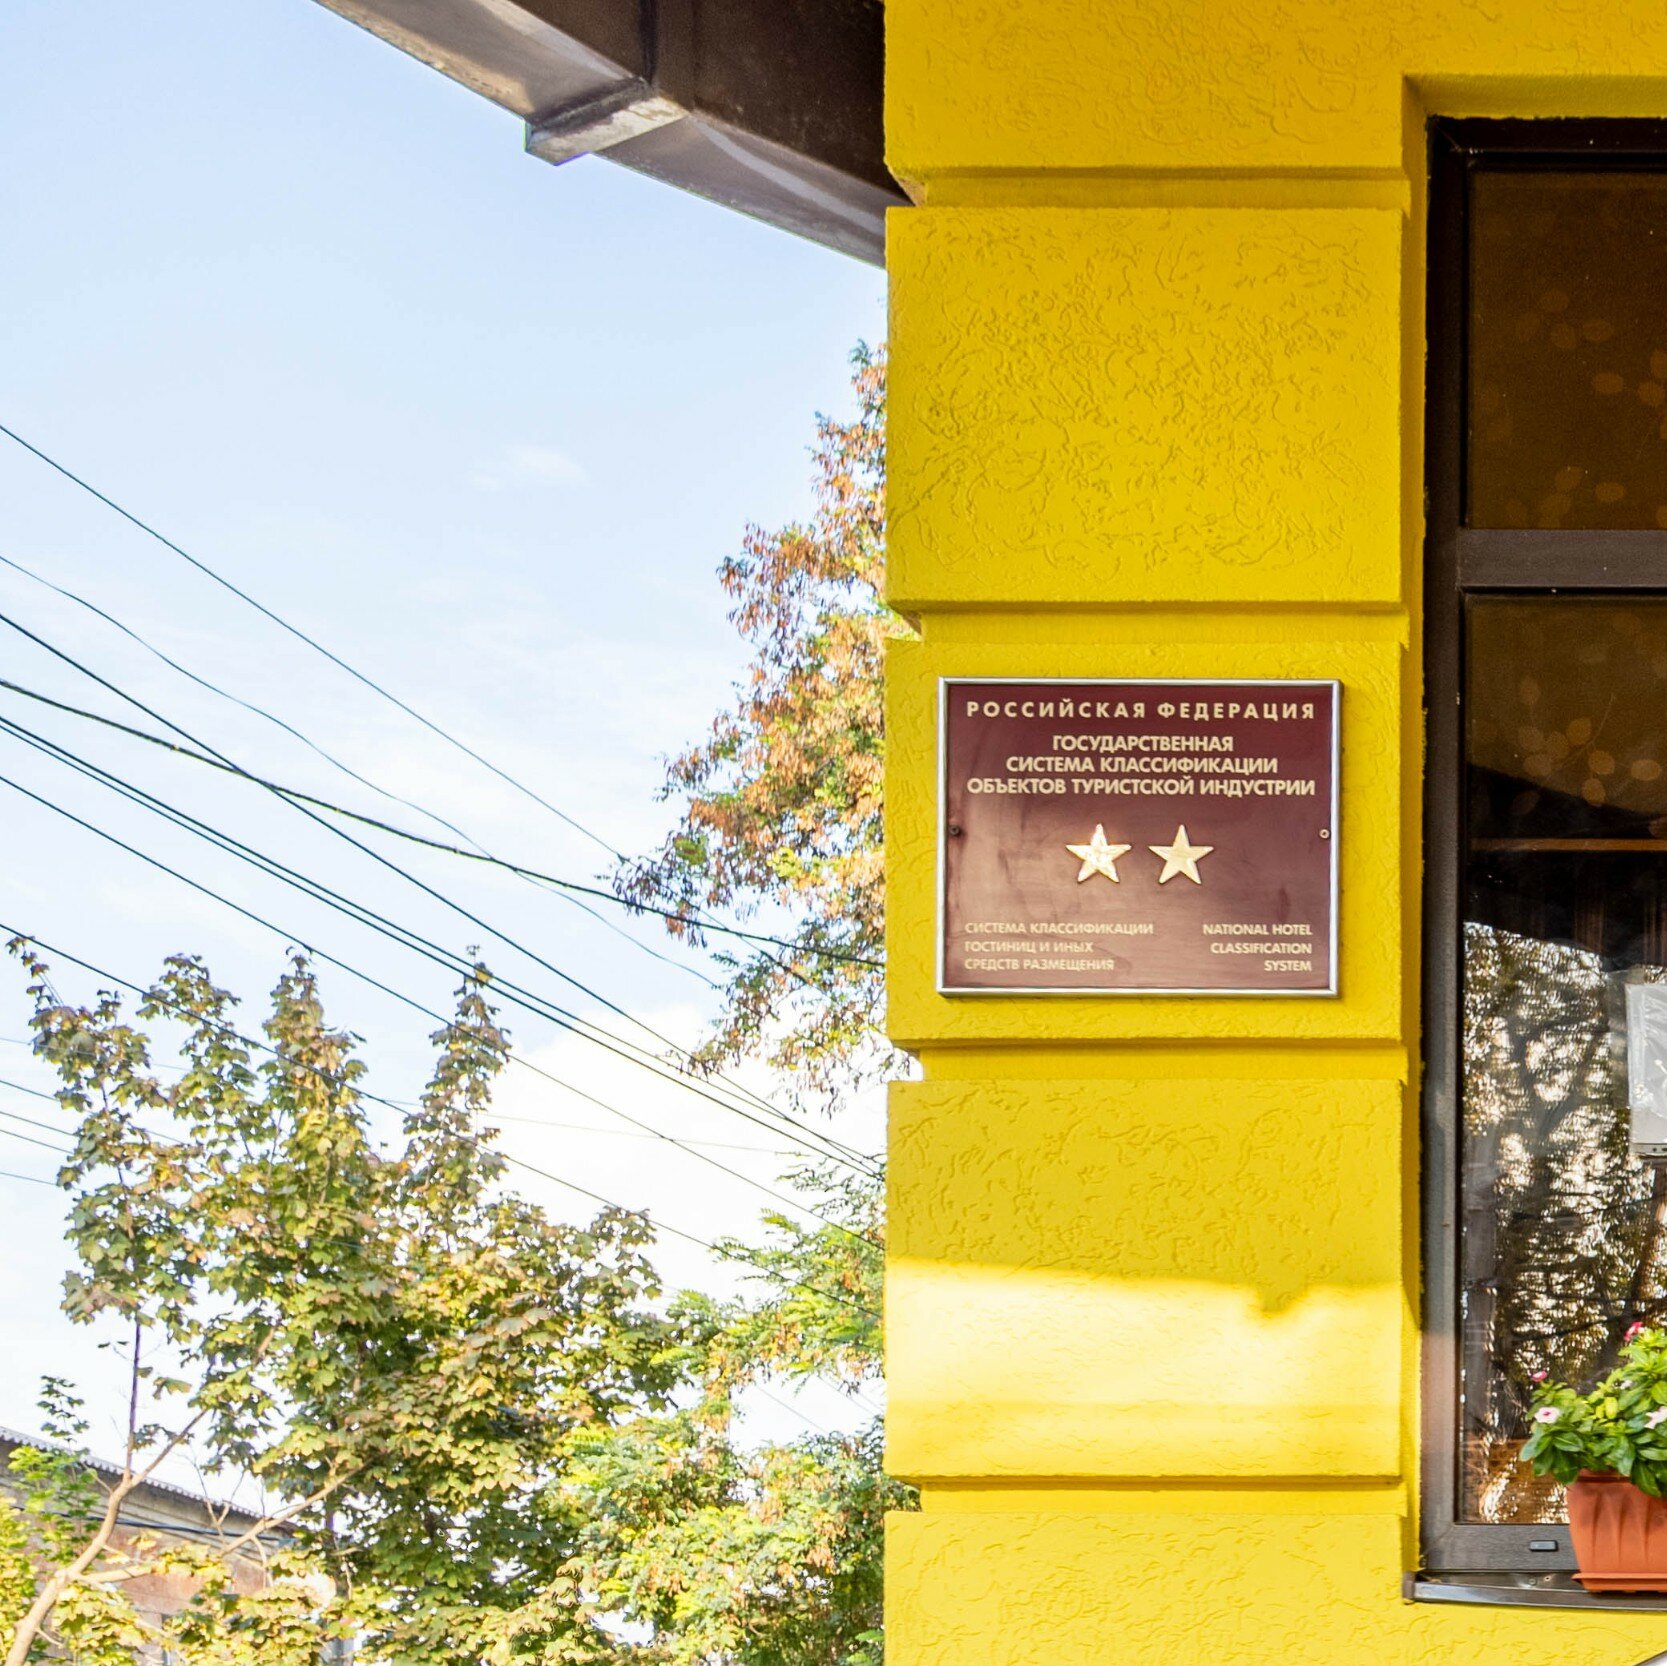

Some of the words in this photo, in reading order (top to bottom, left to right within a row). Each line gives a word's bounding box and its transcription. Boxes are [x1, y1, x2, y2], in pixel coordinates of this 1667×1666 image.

[966, 698, 1146, 719] РОССИЙСКАЯ
[1157, 702, 1315, 721] ФЕДЕРАЦИЯ
[1052, 735, 1233, 754] ГОСУДАРСТВЕННАЯ
[1006, 757, 1094, 773] СИСТЕМА
[1100, 757, 1278, 776] КЛАССИФИКАЦИИ
[966, 779, 1066, 795] ОБЪЕКТОВ
[1072, 775, 1194, 796] ТУРИСТСКОЙ
[1199, 779, 1316, 798] ИНДУСТРИИ
[965, 923, 1026, 935] СИСТЕМА
[1030, 922, 1153, 937] КЛАССИФИКАЦИИ
[1203, 924, 1269, 936] NATIONAL
[1273, 924, 1312, 936] HOTEL
[965, 941, 1036, 955] ГОСТИНИЦ
[1039, 942, 1050, 953] И
[1053, 942, 1093, 953] ИНЫХ
[1210, 943, 1312, 954] CLASSIFICATION
[965, 958, 1019, 972] СРЕДСТВ
[1023, 958, 1114, 972] РАЗМЕЩЕНИЯ
[1264, 960, 1312, 972] SYSTEM
